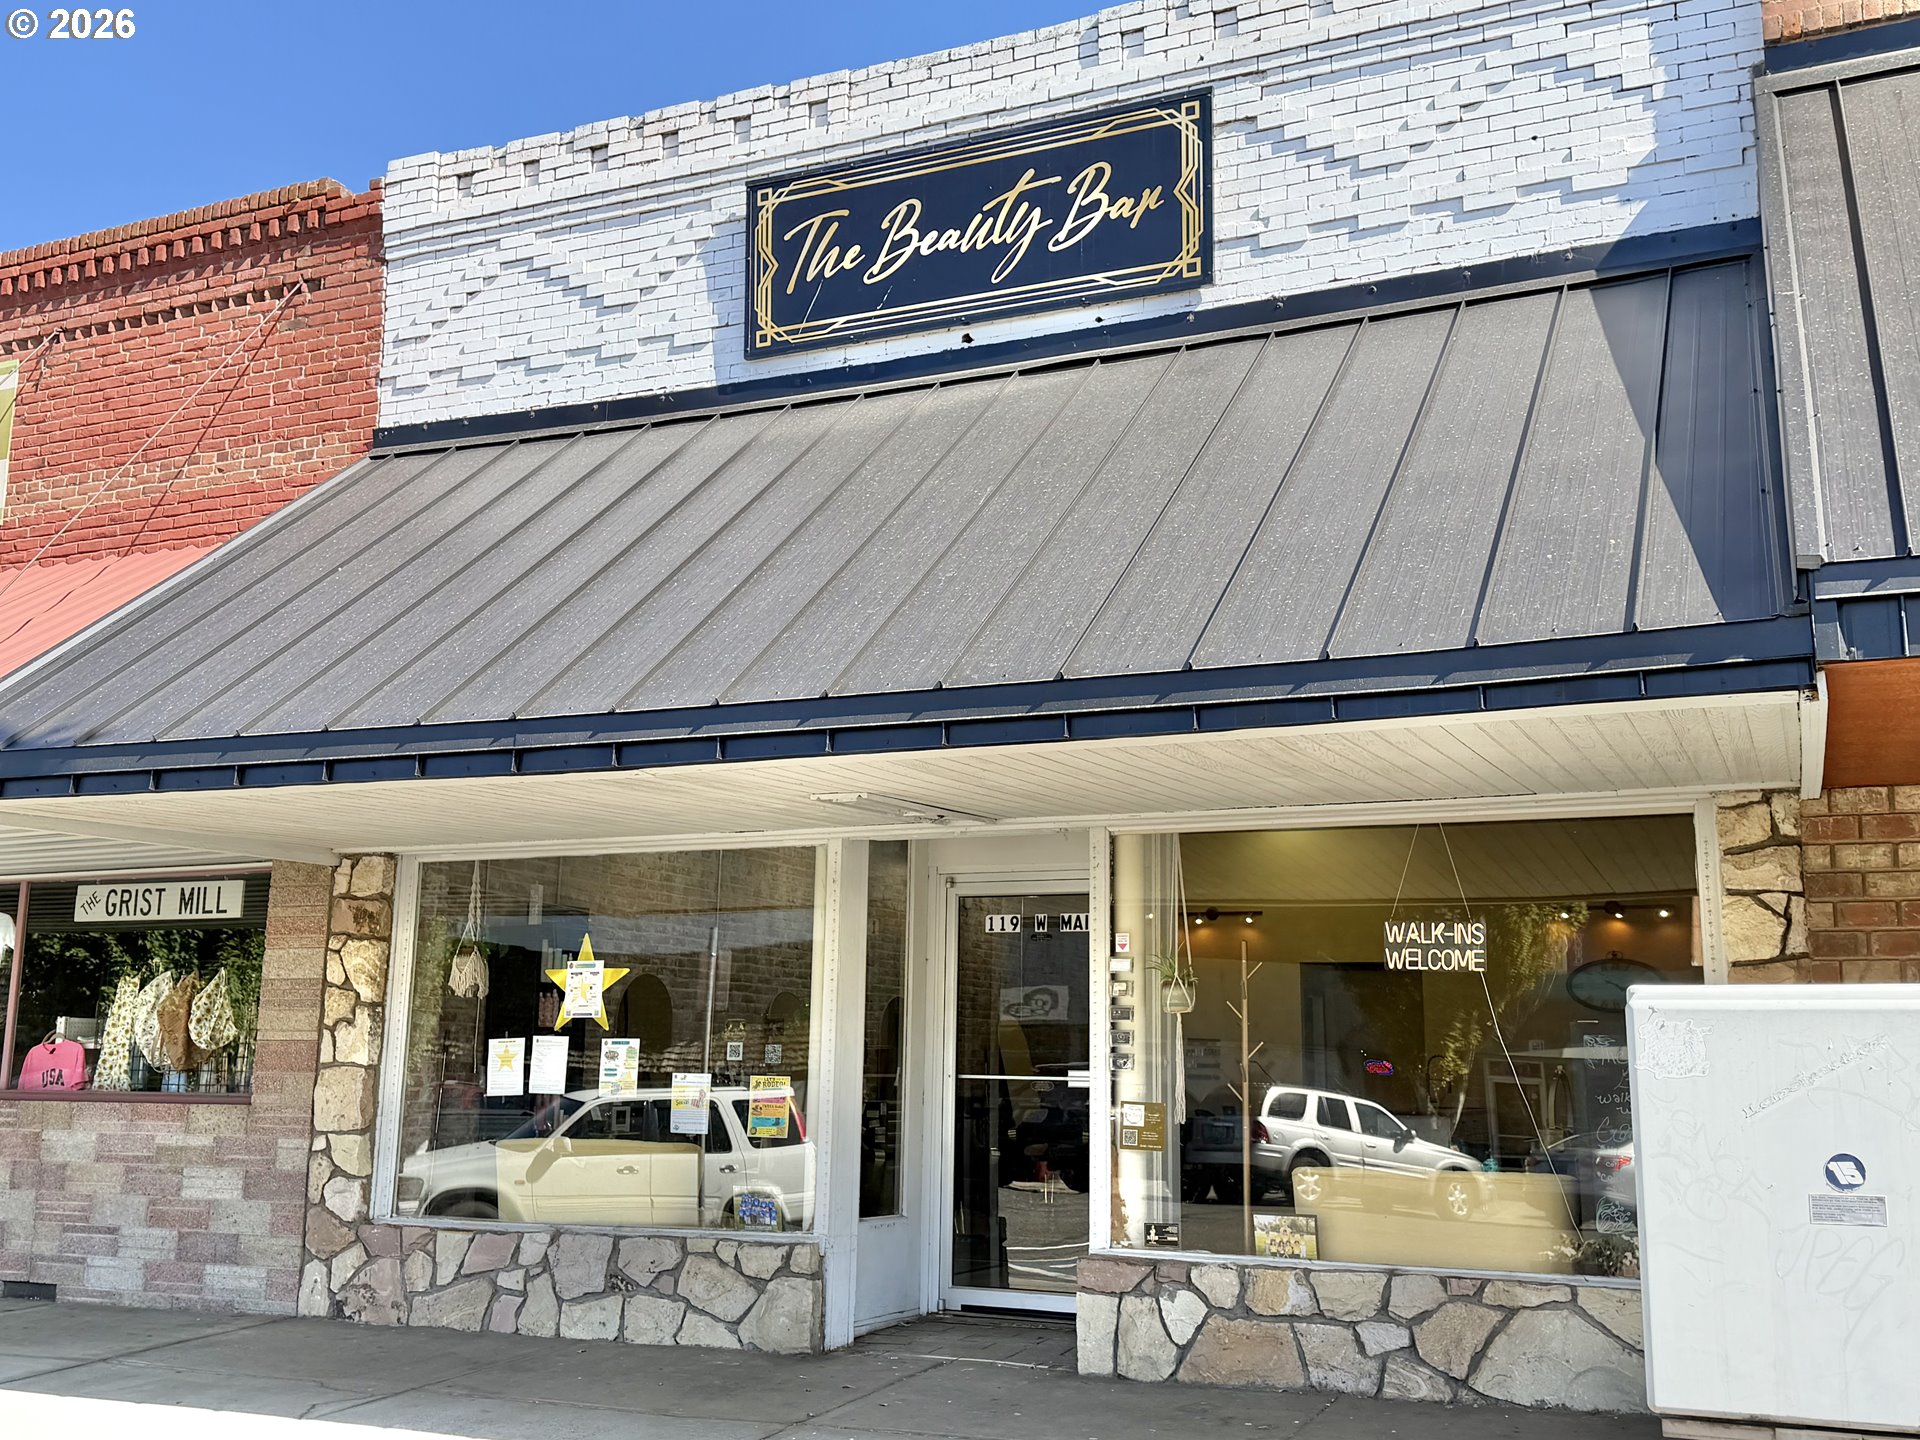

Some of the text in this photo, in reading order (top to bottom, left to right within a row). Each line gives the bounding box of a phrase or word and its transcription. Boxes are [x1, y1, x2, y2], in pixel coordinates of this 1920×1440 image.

[783, 161, 1165, 295] The Beauty Bar
[80, 886, 228, 917] THE GRIST MILL
[988, 914, 1089, 932] 119 W MAI
[1384, 921, 1485, 945] WALK-INS
[1384, 947, 1485, 972] WELCOME
[42, 1068, 65, 1088] USA
[1827, 1161, 1865, 1185] 15
